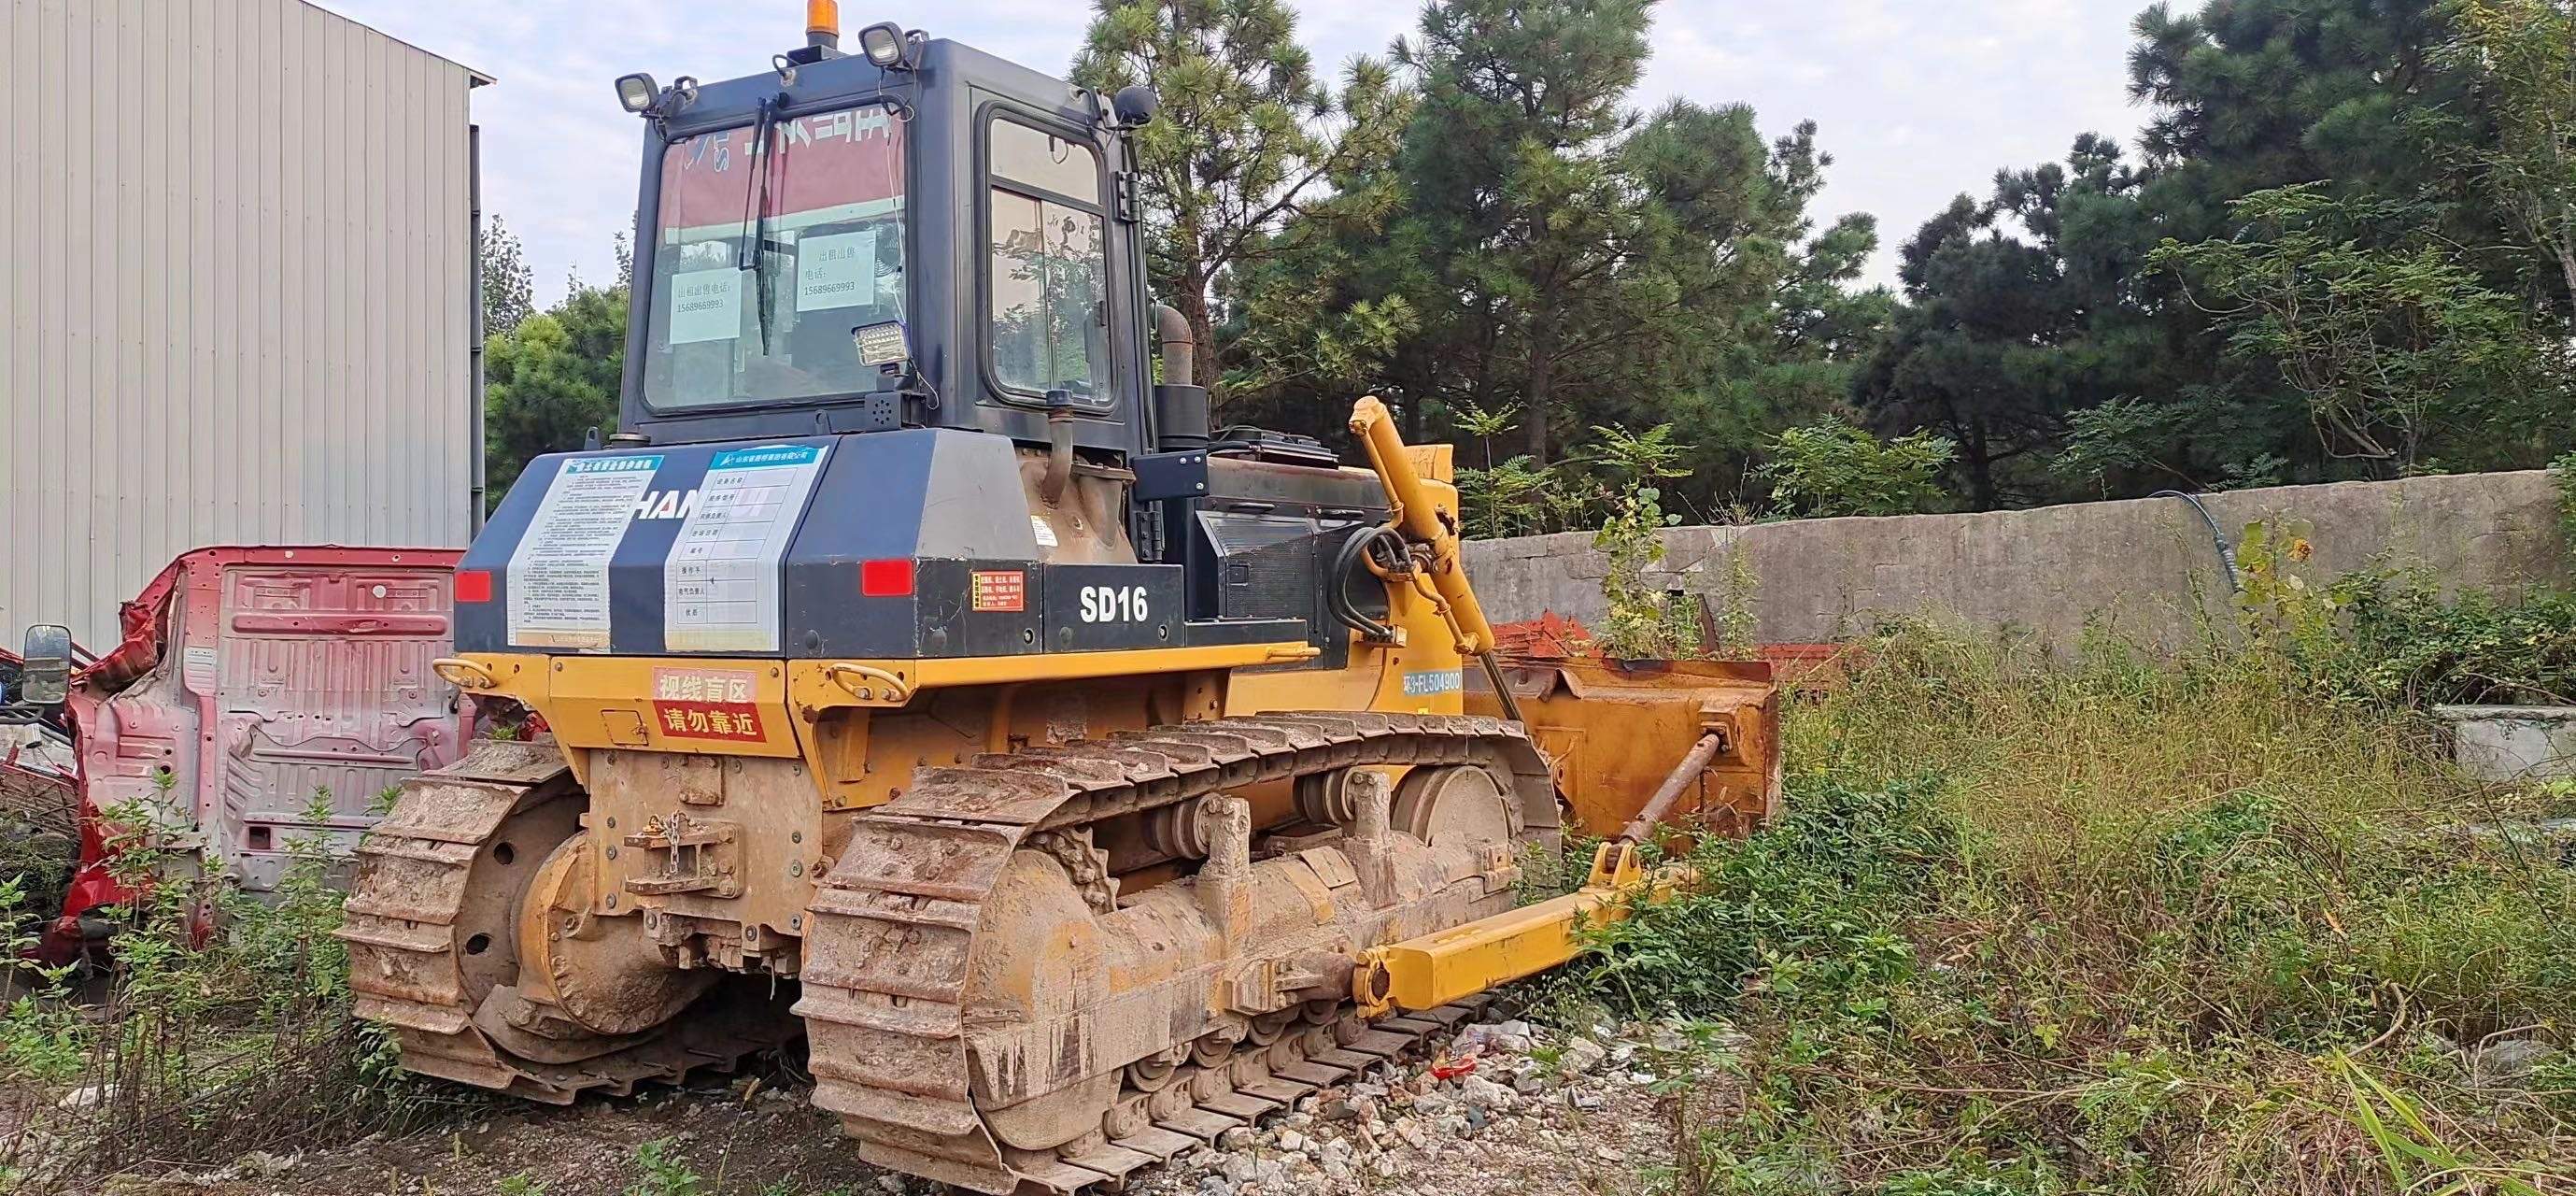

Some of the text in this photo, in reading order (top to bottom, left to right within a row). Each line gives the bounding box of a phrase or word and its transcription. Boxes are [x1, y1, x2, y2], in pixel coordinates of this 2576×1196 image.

[1080, 585, 1149, 623] SD16
[659, 674, 749, 704] 视线盲区
[1403, 672, 1461, 693] 环3-FL504900
[663, 707, 757, 736] 请勿靠近
